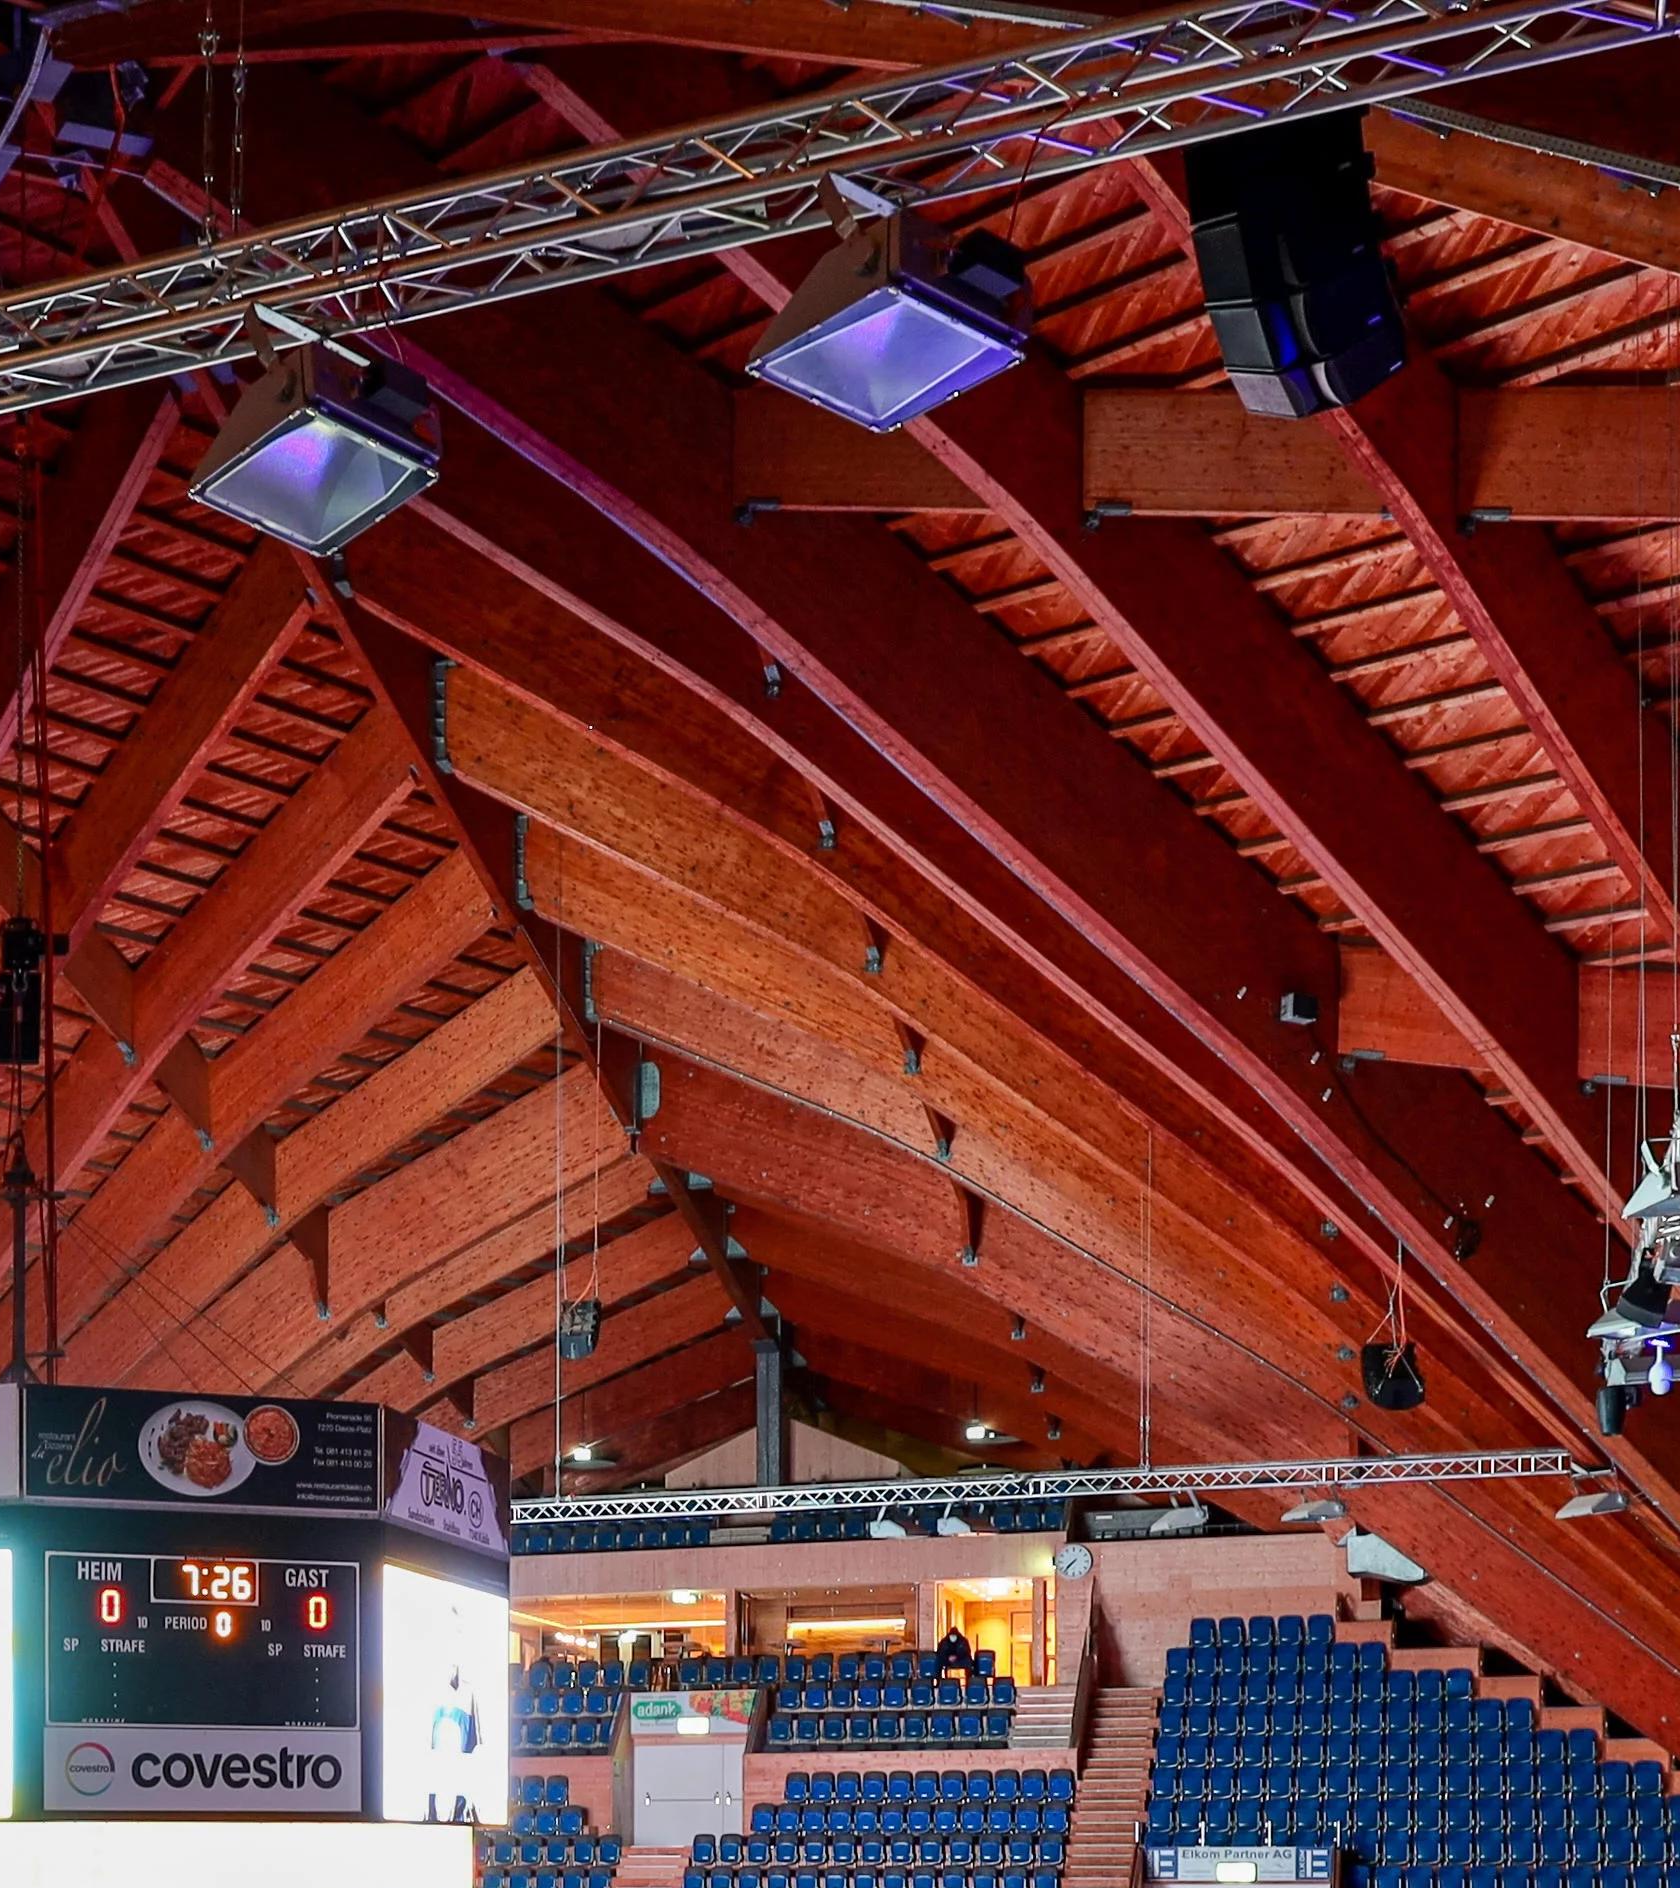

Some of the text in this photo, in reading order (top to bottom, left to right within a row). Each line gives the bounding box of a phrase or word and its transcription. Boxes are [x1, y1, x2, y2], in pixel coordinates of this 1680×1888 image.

[77, 1561, 122, 1582] HEIM
[285, 1569, 329, 1587] GAST
[182, 1564, 251, 1600] 7:26
[100, 1589, 121, 1623] 0
[309, 1596, 327, 1628] 0
[138, 1617, 148, 1628] 10
[165, 1617, 207, 1630] PERIOD
[261, 1620, 271, 1632] 10
[64, 1638, 145, 1653] SP STRAFE
[268, 1643, 346, 1658] SP STRAFE
[69, 1764, 109, 1773] covestro
[131, 1747, 342, 1789] covestro
[1182, 1850, 1292, 1859] Elkom Partner AG
